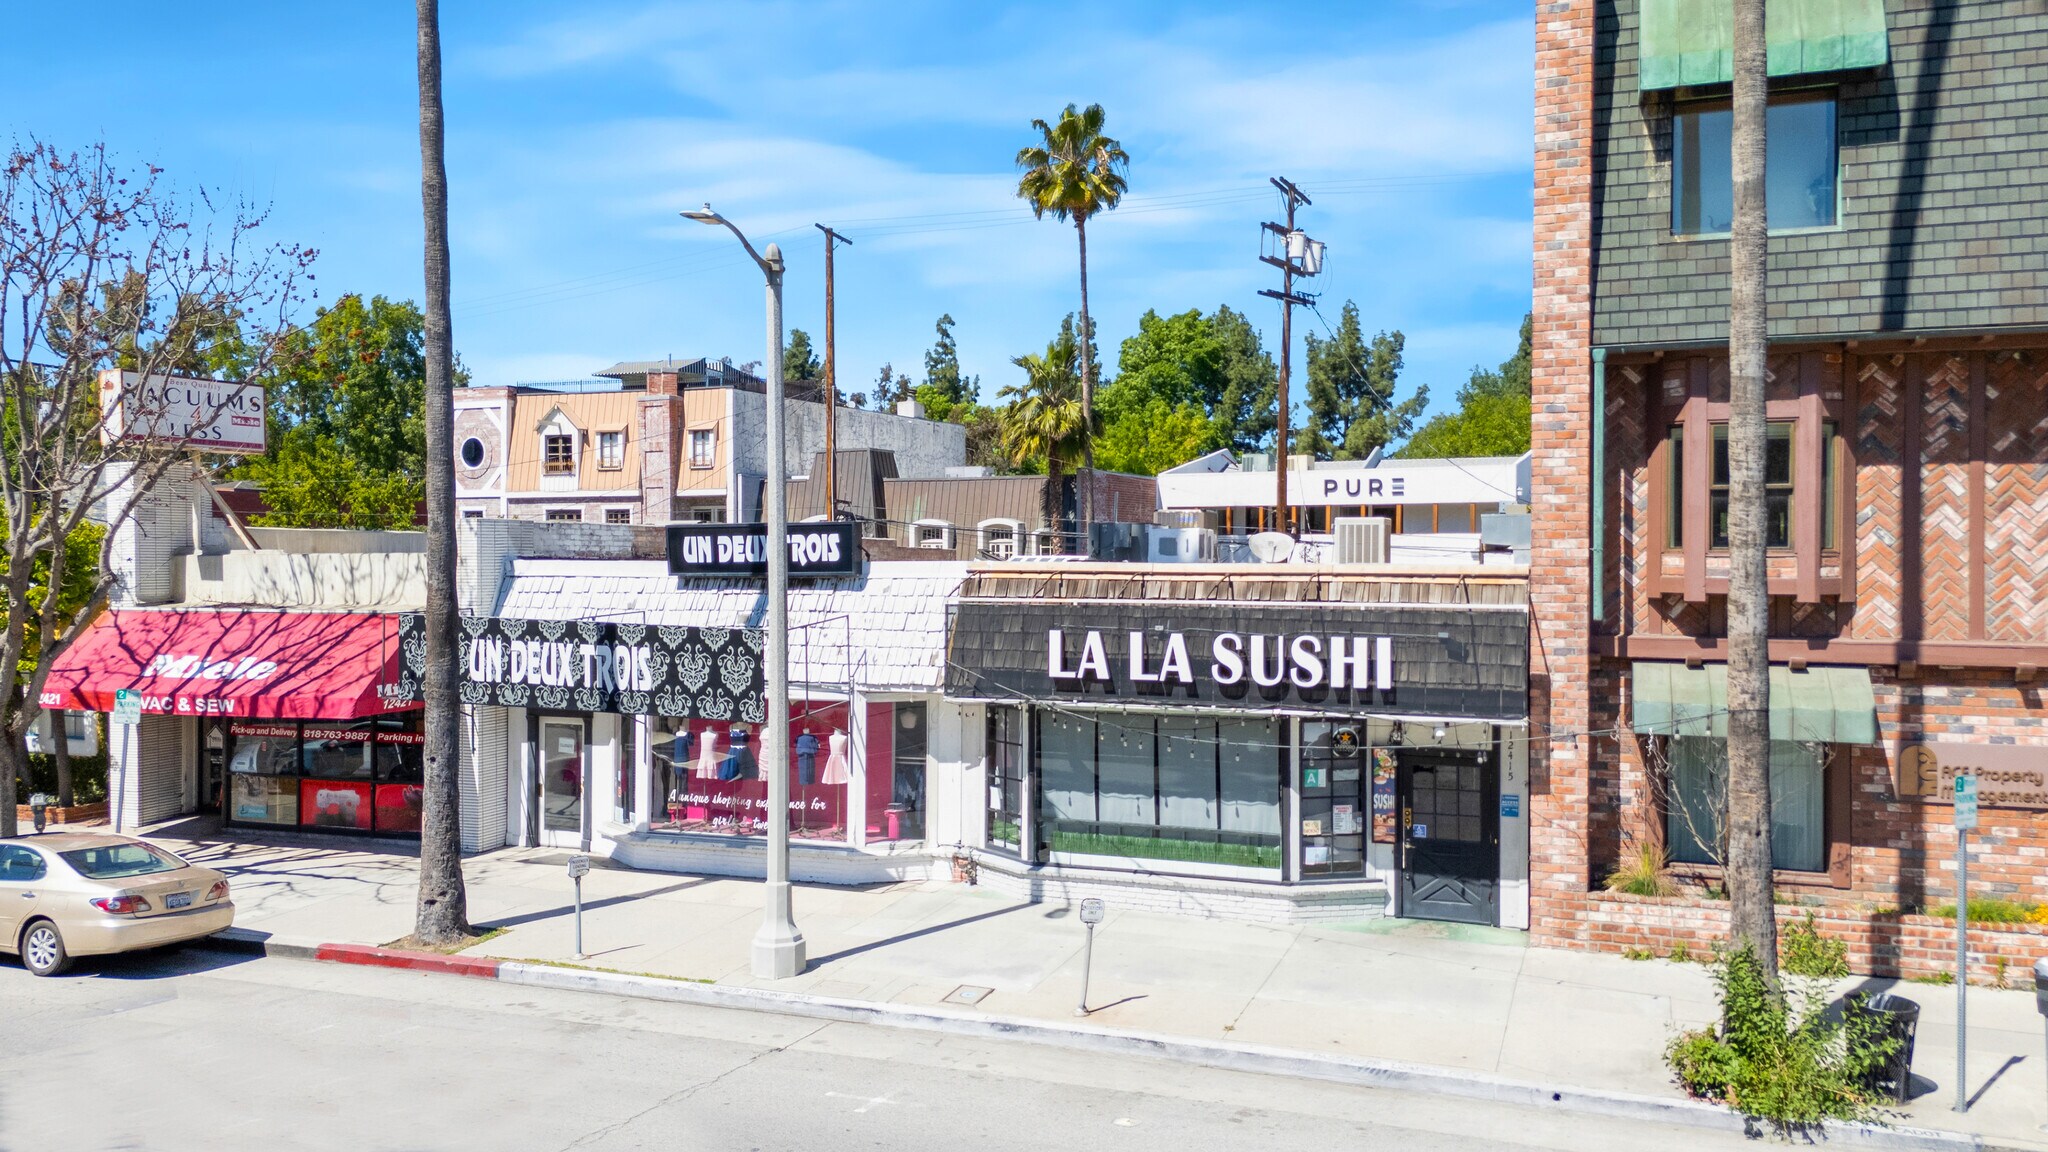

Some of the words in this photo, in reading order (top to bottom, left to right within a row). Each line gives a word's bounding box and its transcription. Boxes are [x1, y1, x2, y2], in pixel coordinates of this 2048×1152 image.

[169, 378, 187, 387] Best
[191, 380, 221, 392] Quality
[1324, 478, 1404, 497] PURE
[683, 535, 712, 563] UN
[786, 533, 840, 566] ROIS
[143, 655, 277, 680] Miele
[469, 639, 501, 683] UN
[511, 640, 575, 687] DEUX
[580, 644, 651, 694] TROIS
[1049, 630, 1110, 680] LA
[1130, 631, 1193, 682] LA
[1211, 633, 1391, 689] SUSHI
[140, 696, 173, 710] VAC
[178, 697, 191, 712] &
[195, 698, 235, 712] SEW
[231, 726, 255, 735] Pick-up
[256, 727, 269, 735] and
[271, 727, 297, 738] Delivery
[303, 729, 370, 741] 818-763-9887
[377, 732, 413, 743] Parking
[416, 734, 424, 742] in
[1975, 766, 2042, 787] Property
[668, 788, 676, 802] A
[679, 794, 709, 806] unique
[712, 792, 751, 810] shopping
[810, 797, 826, 810] for
[1373, 794, 1395, 809] SUSHI
